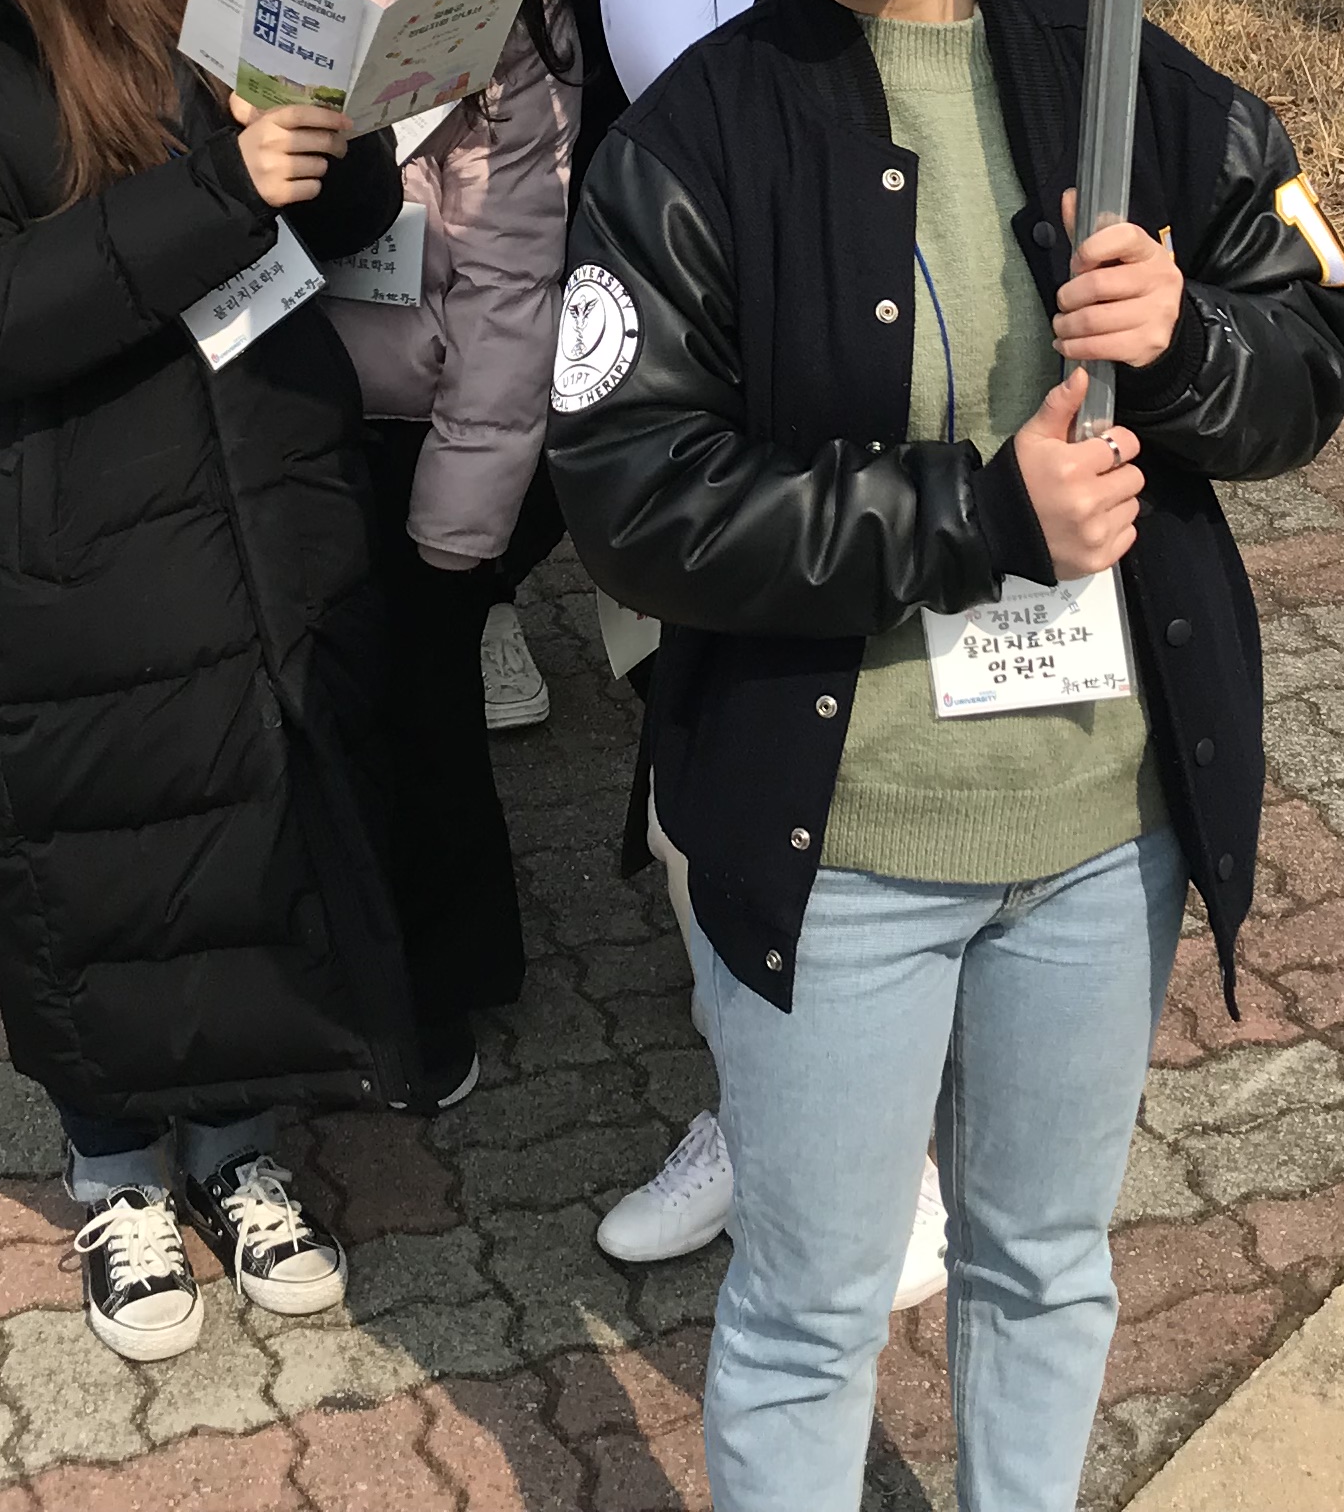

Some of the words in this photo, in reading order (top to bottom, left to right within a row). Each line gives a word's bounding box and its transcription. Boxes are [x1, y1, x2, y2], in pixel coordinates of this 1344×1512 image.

[257, 8, 298, 39] 바로
[255, 25, 335, 70] 지금부터
[213, 260, 285, 320] 물리치료학과
[579, 356, 632, 406] THERAPY
[987, 604, 1049, 630] 정지윤
[962, 626, 1093, 659] 물리치료학과
[988, 655, 1056, 684] 임원진
